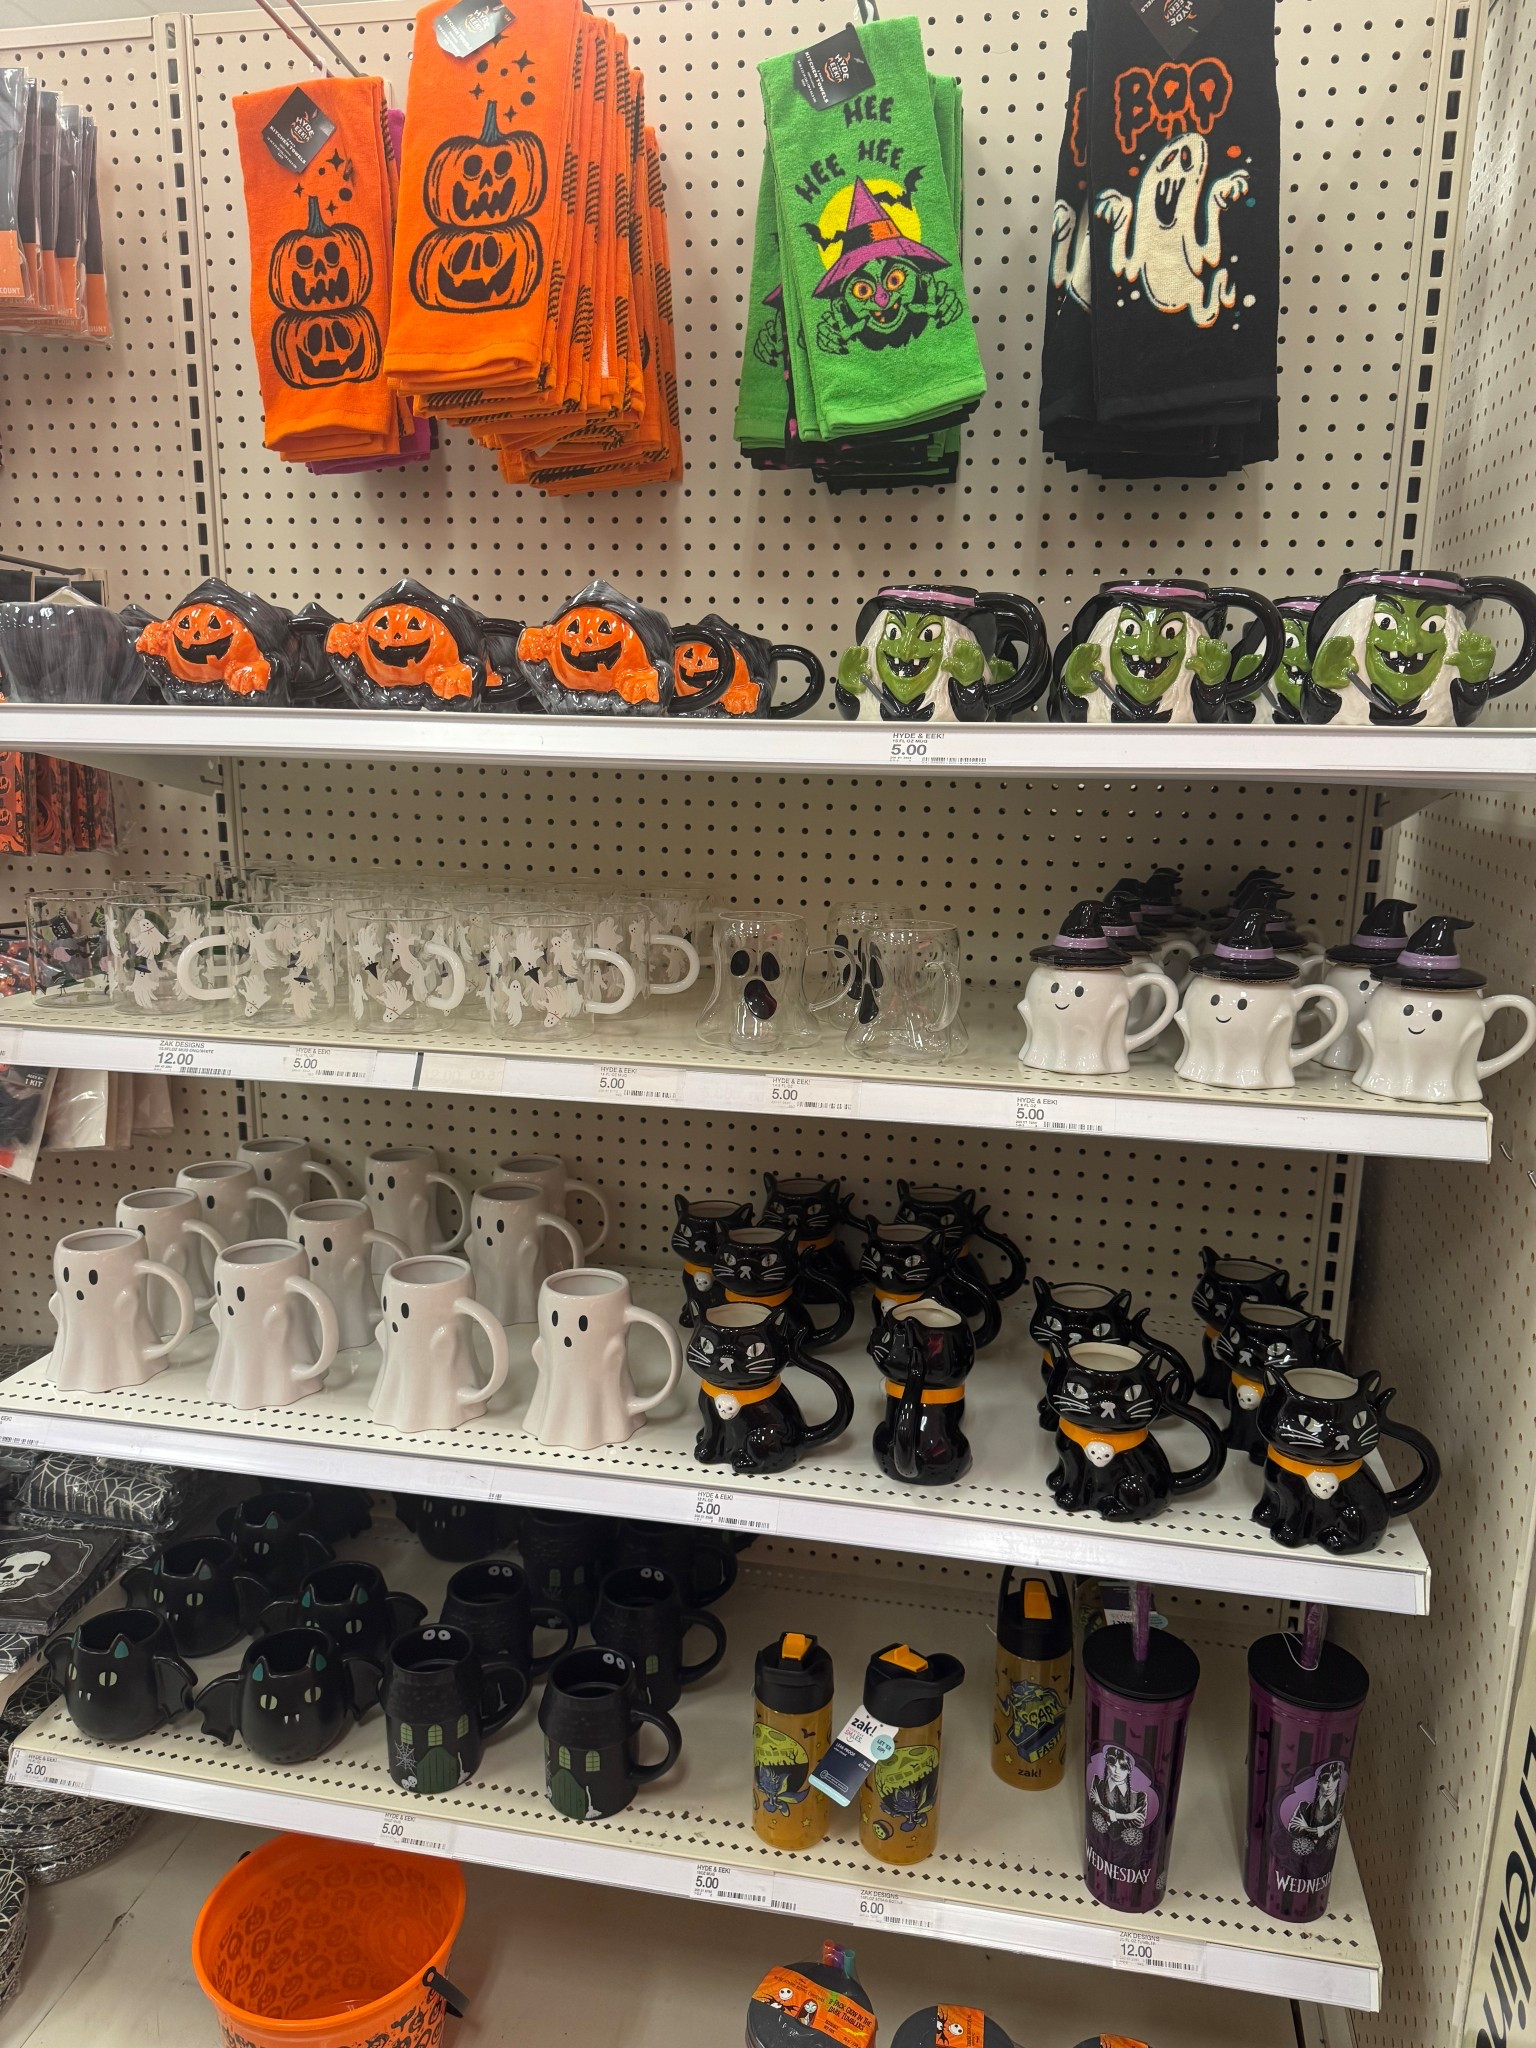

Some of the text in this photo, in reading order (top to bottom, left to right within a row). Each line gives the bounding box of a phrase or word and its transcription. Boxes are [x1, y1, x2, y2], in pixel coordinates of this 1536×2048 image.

[1170, 0, 1194, 26] HYDE
[835, 54, 849, 80] HYDE
[804, 51, 819, 75] KITCHEN
[816, 76, 829, 104] TOWELS
[844, 94, 894, 128] HEE
[1114, 57, 1233, 155] BOO
[296, 116, 315, 136] HYDE
[270, 125, 289, 147] KITCHEN
[289, 146, 307, 164] TOWELS
[795, 138, 904, 204] HEE HEE
[891, 744, 927, 755] 5.00
[158, 1052, 193, 1065] 12.00
[293, 1058, 317, 1069] 5.00
[30, 1079, 43, 1087] KIT
[600, 1078, 625, 1089] 5.00
[772, 1089, 798, 1100] 5.00
[1016, 1108, 1044, 1120] 5.00
[696, 1502, 720, 1515] 5.00
[1022, 1701, 1060, 1724] SCARY
[851, 1718, 877, 1736] zak!
[1036, 1731, 1062, 1759] FAST!
[25, 1763, 46, 1776] 5.00
[1018, 1769, 1042, 1778] zak!
[385, 1812, 399, 1820] HYDE
[382, 1823, 404, 1836] 5.00
[697, 1864, 712, 1872] HYDE
[1086, 1838, 1151, 1885] WEDNESDAY
[695, 1876, 719, 1889] 5.00
[874, 1891, 899, 1899] DESIGNS
[860, 1901, 884, 1915] 6.00
[1133, 1933, 1160, 1942] DESIGNS
[1120, 1943, 1152, 1958] 12.00
[841, 2012, 865, 2031] TUMBLERS
[864, 2017, 872, 2027] THE
